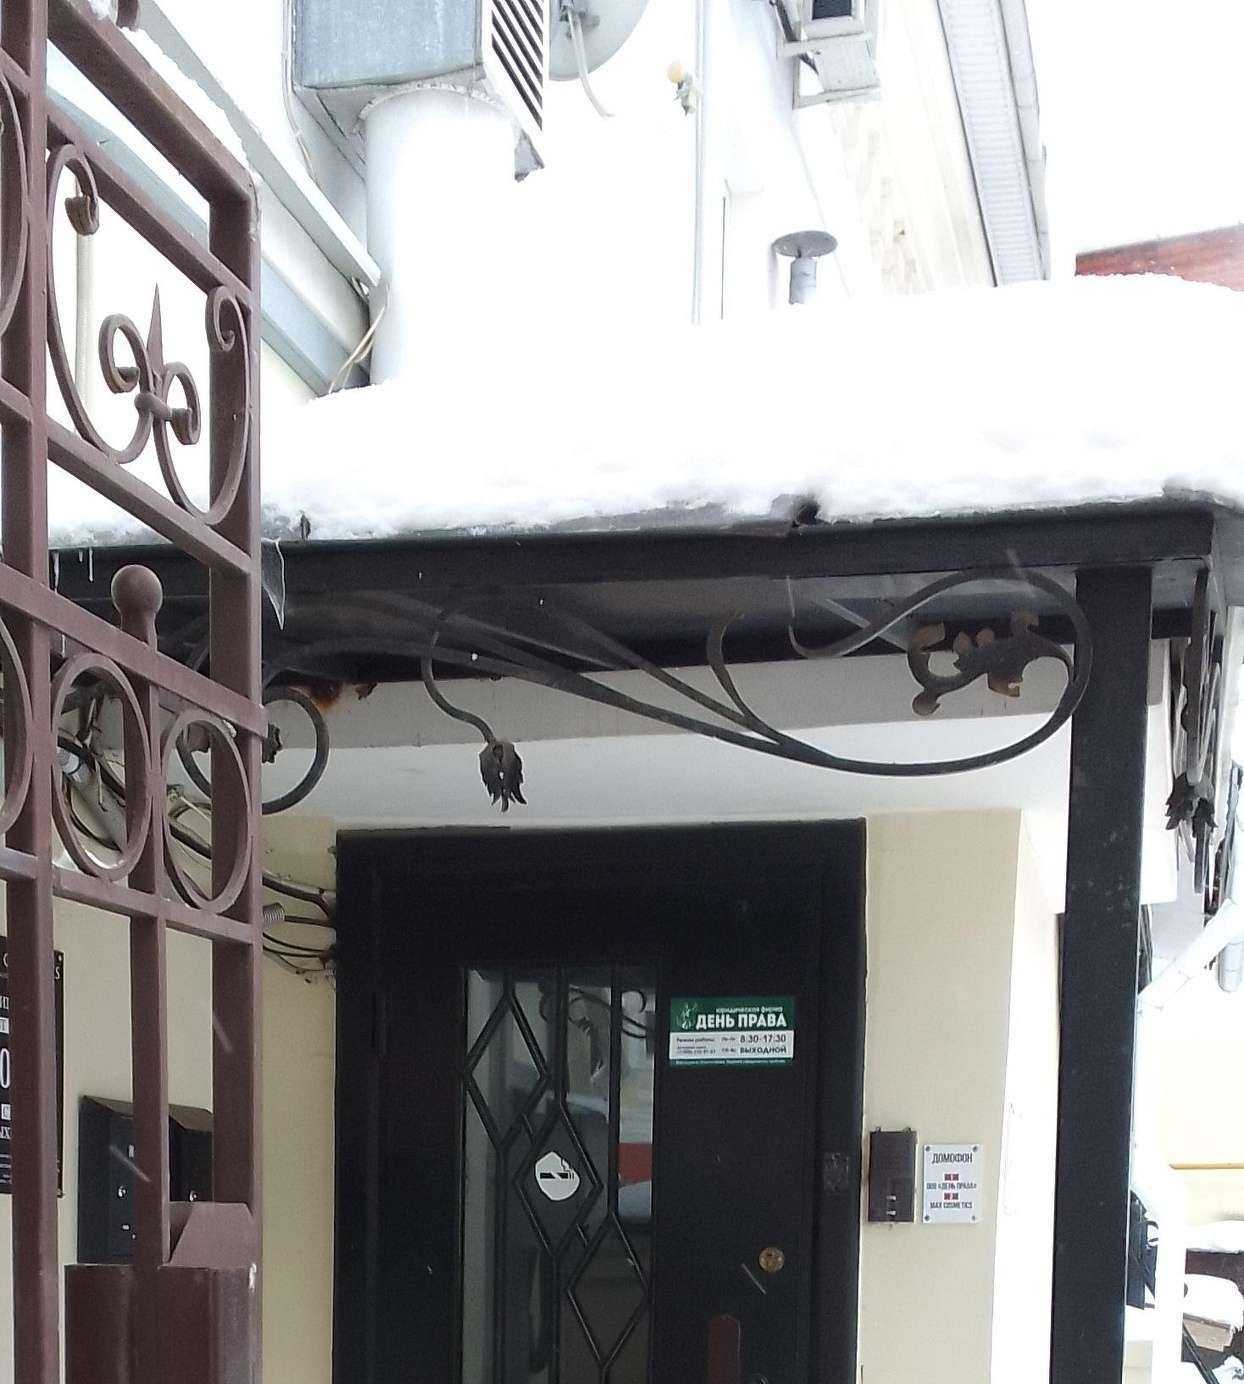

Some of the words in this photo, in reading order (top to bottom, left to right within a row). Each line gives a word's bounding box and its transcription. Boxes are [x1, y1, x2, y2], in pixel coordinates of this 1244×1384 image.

[696, 1013, 735, 1030] ДЕНЬ
[737, 1012, 787, 1028] ПРАВА
[740, 1045, 787, 1054] ВЫХОДНОЙ
[931, 1152, 973, 1164] ДОМОФОН
